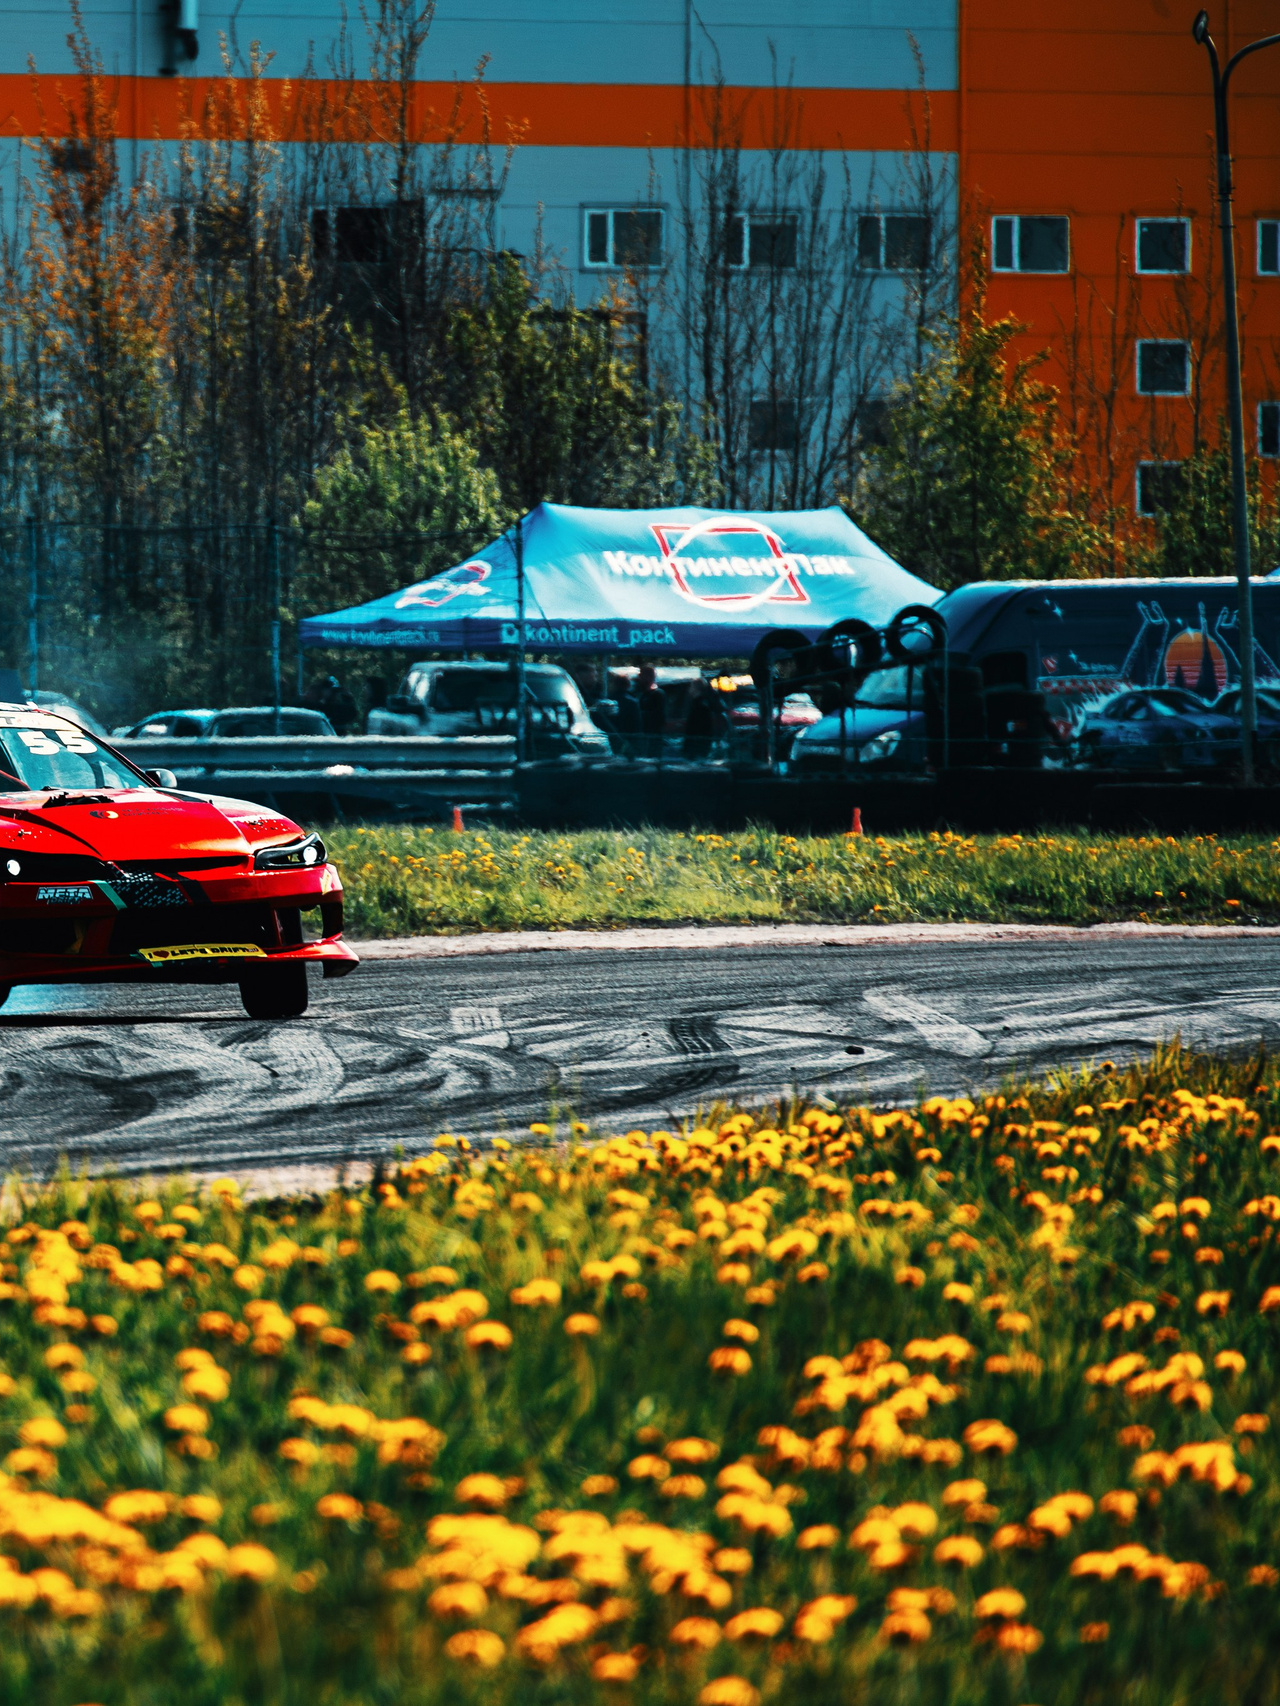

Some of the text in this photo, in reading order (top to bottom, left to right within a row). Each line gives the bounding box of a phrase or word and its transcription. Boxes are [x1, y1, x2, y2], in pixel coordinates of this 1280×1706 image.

[524, 623, 677, 648] kontinent_pack
[17, 730, 97, 755] 55
[38, 888, 91, 899] META
